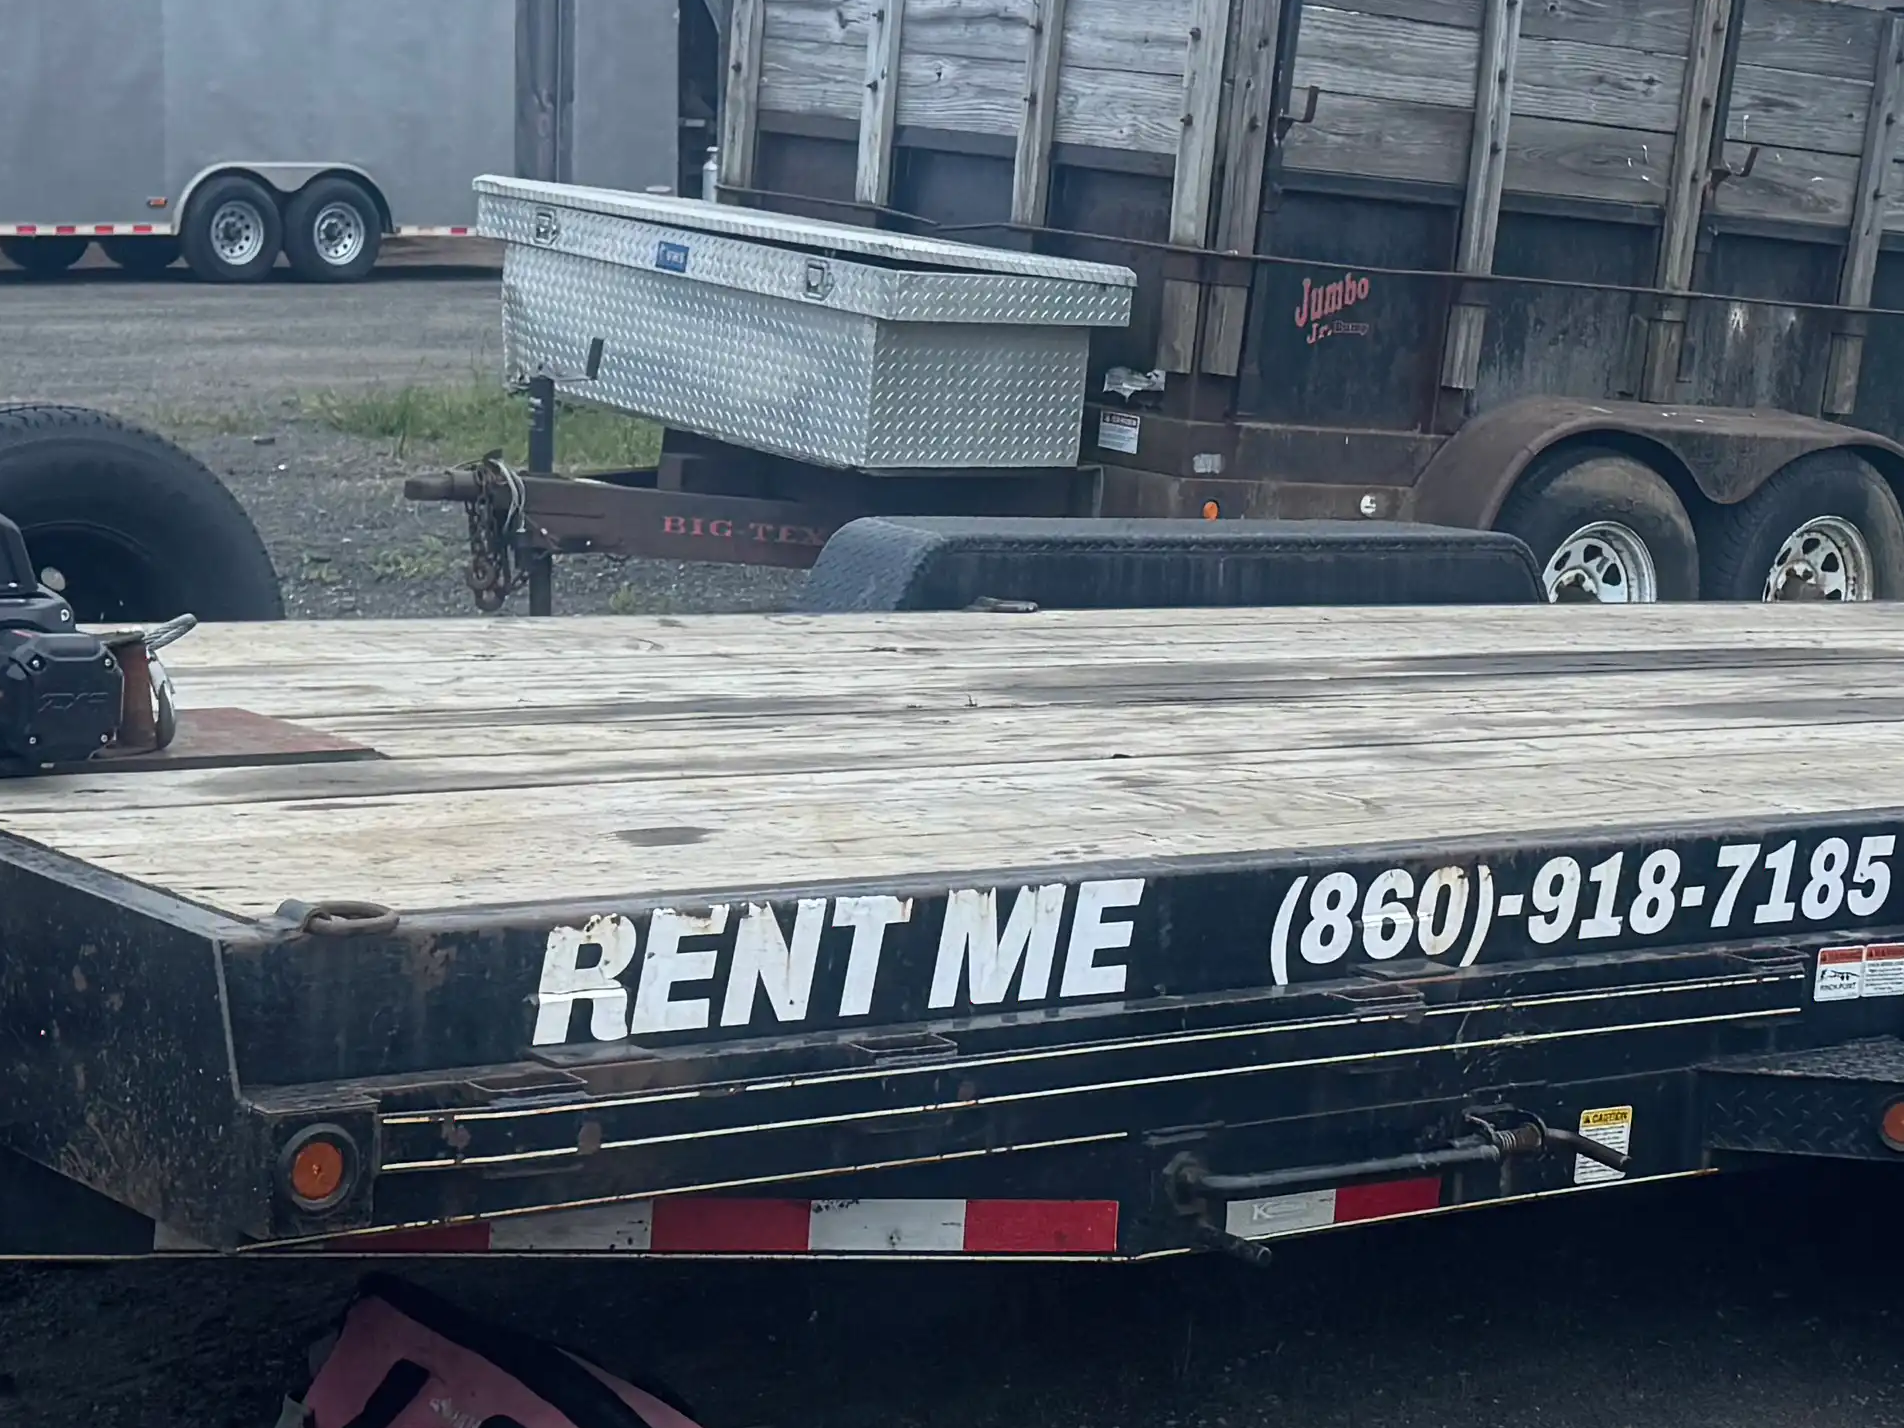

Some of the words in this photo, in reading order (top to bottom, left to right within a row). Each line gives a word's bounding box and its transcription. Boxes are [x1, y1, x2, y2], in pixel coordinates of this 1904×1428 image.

[1295, 272, 1369, 327] Jumbo
[1306, 323, 1332, 344] Jr.
[532, 896, 914, 1045] RENT
[927, 877, 1146, 1010] ME
[1270, 834, 1896, 986] (860)-918-7185
